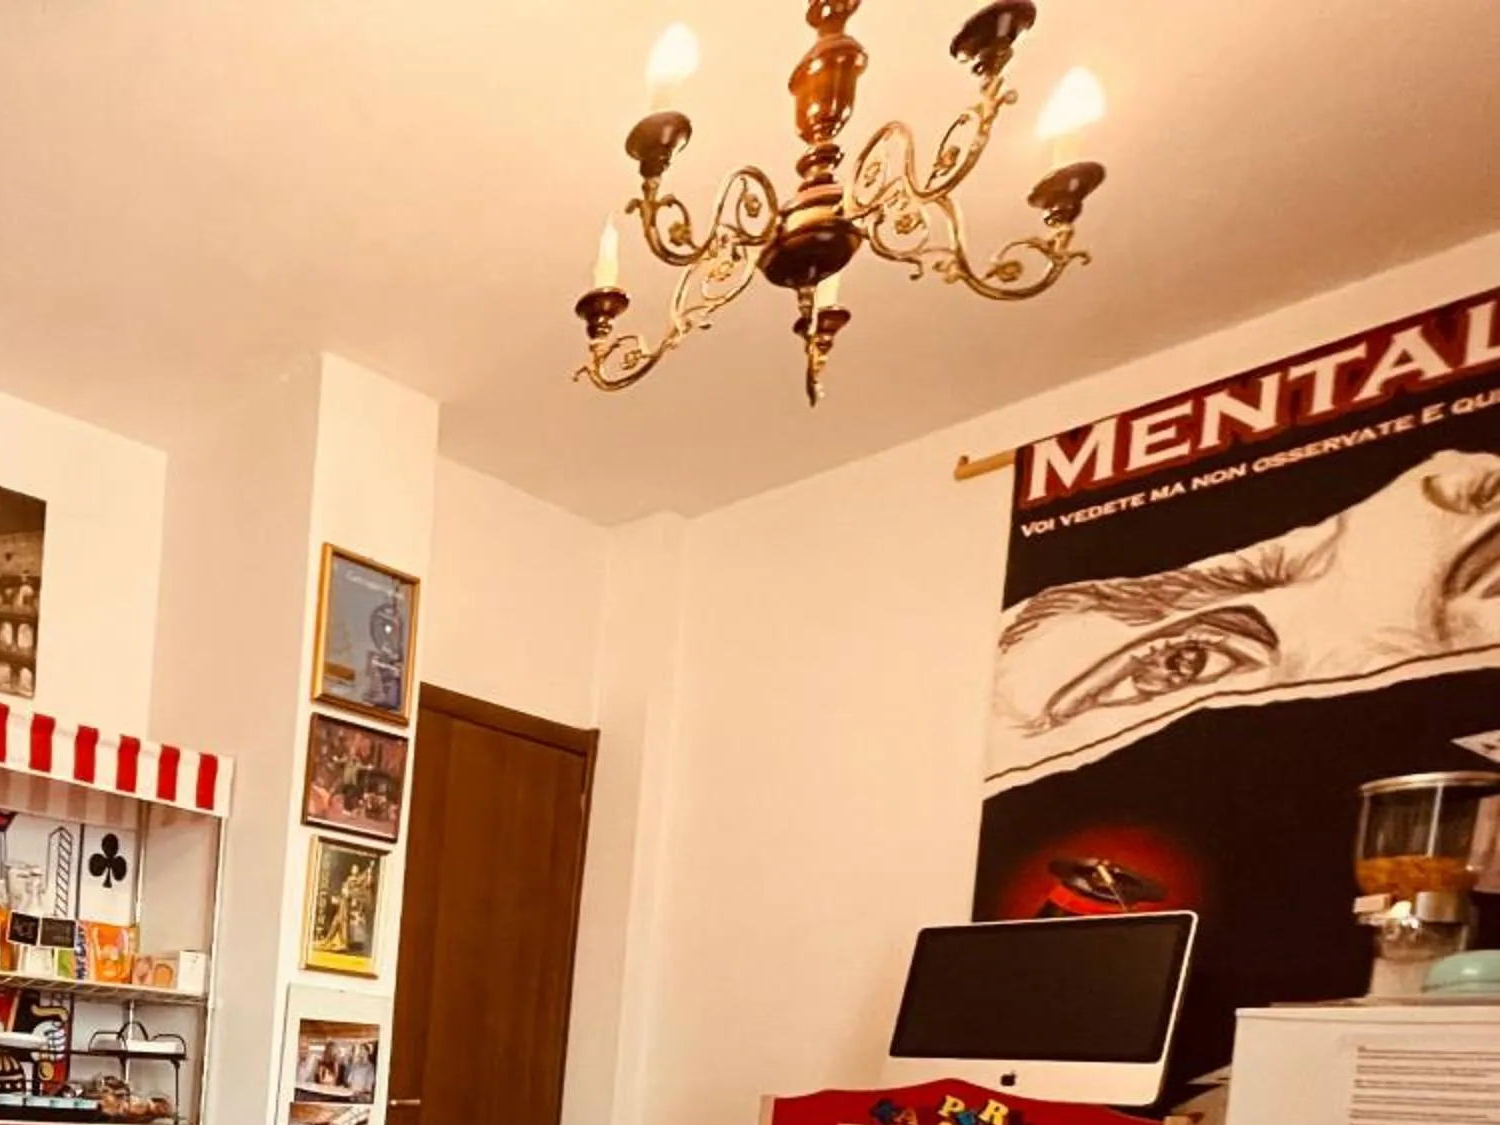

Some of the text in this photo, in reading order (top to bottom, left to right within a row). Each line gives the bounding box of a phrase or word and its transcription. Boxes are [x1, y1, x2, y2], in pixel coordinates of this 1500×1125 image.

[1020, 517, 1055, 538] VOI
[1060, 491, 1146, 527] VEDETE
[1149, 481, 1186, 503] MA
[1190, 461, 1248, 491] NON
[1251, 414, 1417, 474] OSSERVATE
[1421, 401, 1446, 425] E
